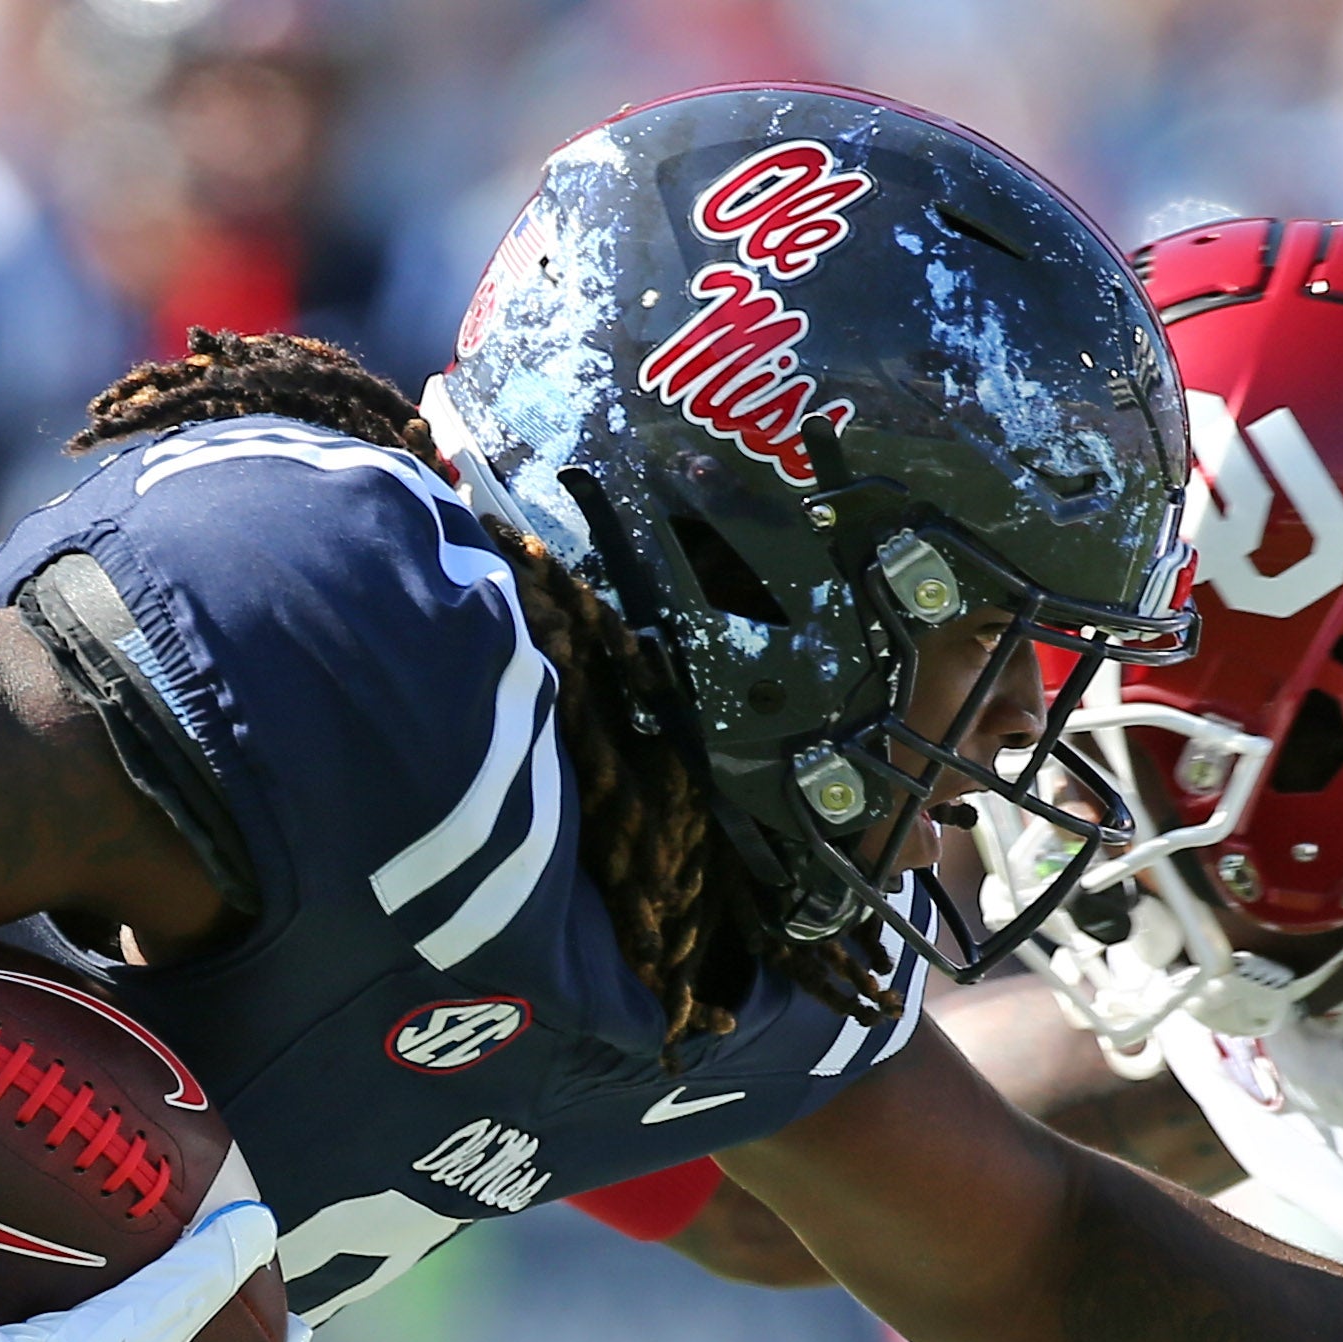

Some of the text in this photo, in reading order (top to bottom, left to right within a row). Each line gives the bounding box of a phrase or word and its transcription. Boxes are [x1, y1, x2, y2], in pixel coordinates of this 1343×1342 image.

[695, 140, 872, 279] Ole
[640, 263, 855, 486] Miss
[396, 1002, 521, 1068] SEC
[412, 1118, 552, 1213] Ole Miss
